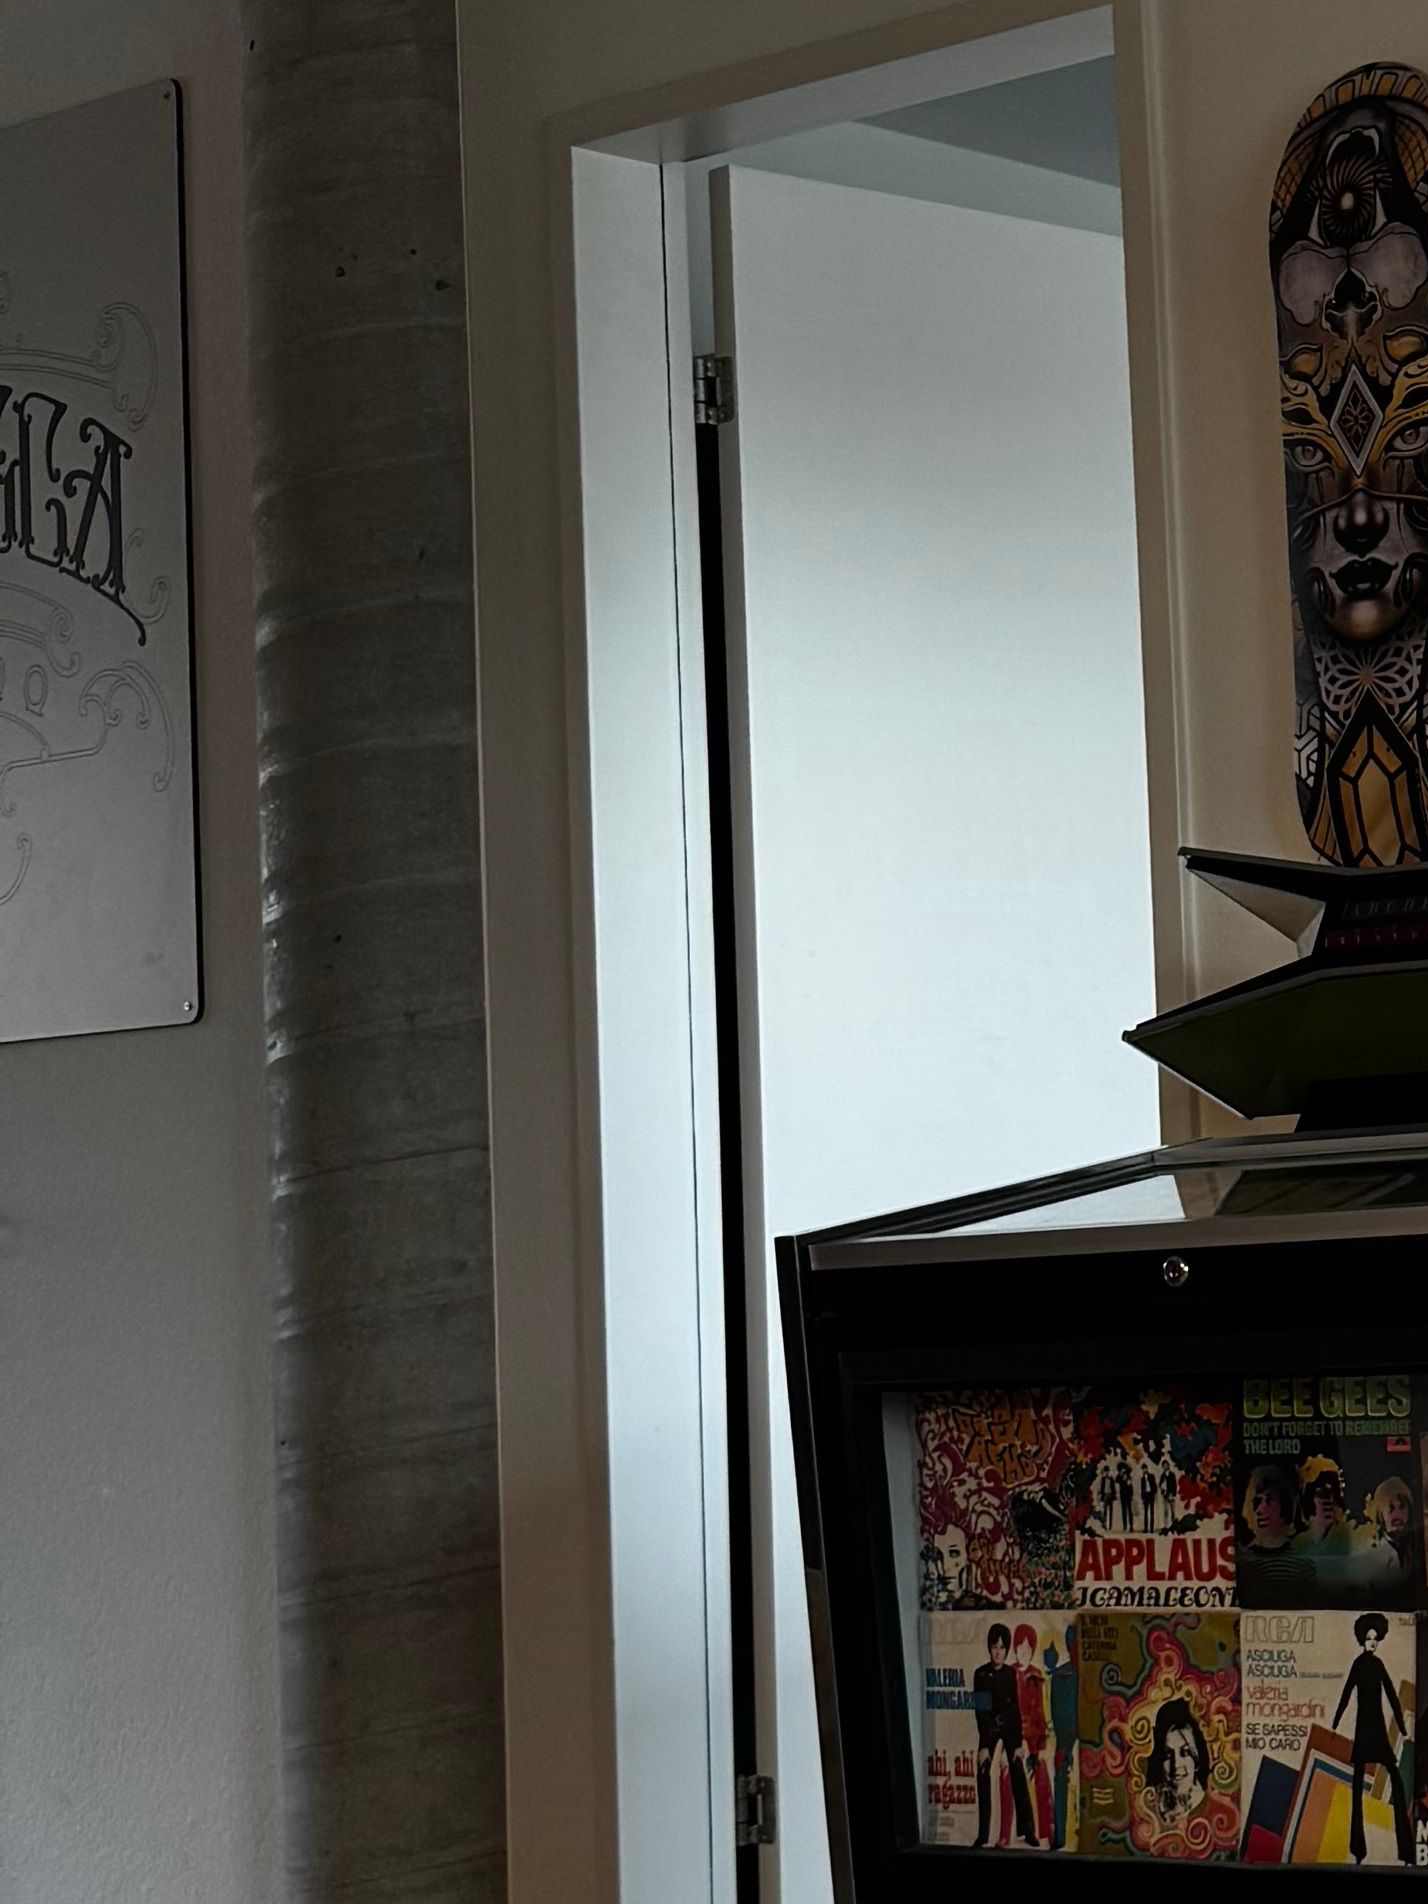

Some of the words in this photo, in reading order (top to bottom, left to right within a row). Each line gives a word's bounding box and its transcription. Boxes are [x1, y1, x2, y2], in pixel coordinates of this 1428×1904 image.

[1243, 1377, 1313, 1419] BEE
[1320, 1376, 1412, 1418] GEES
[1242, 1421, 1280, 1438] DON'T
[1282, 1421, 1325, 1437] FORGET
[1329, 1420, 1343, 1437] TO
[1243, 1439, 1267, 1455] THE
[1269, 1438, 1300, 1455] LORD
[1244, 1615, 1315, 1644] RCA
[1245, 1722, 1261, 1736] SE
[1245, 1737, 1266, 1750] MIO
[1269, 1737, 1301, 1752] CARO
[954, 1750, 975, 1777] ahi
[928, 1783, 976, 1809] ragazzo
